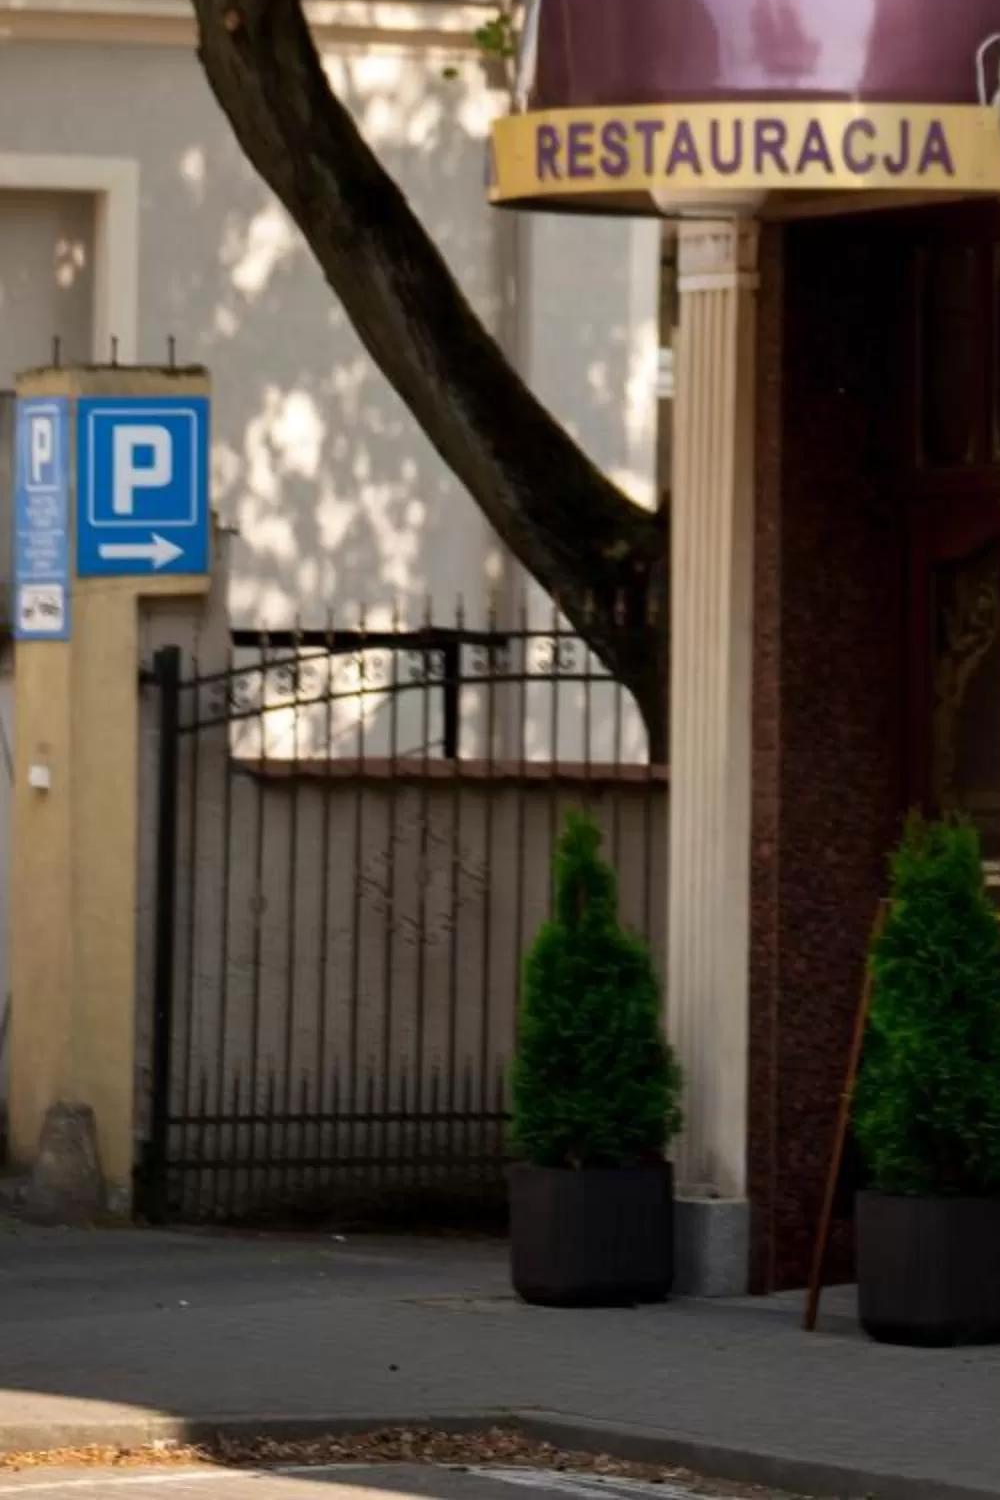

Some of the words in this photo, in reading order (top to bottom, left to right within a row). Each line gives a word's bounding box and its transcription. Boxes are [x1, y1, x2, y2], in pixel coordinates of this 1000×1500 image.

[535, 118, 955, 181] RESTAURACJA
[31, 416, 53, 482] P
[112, 425, 173, 516] P
